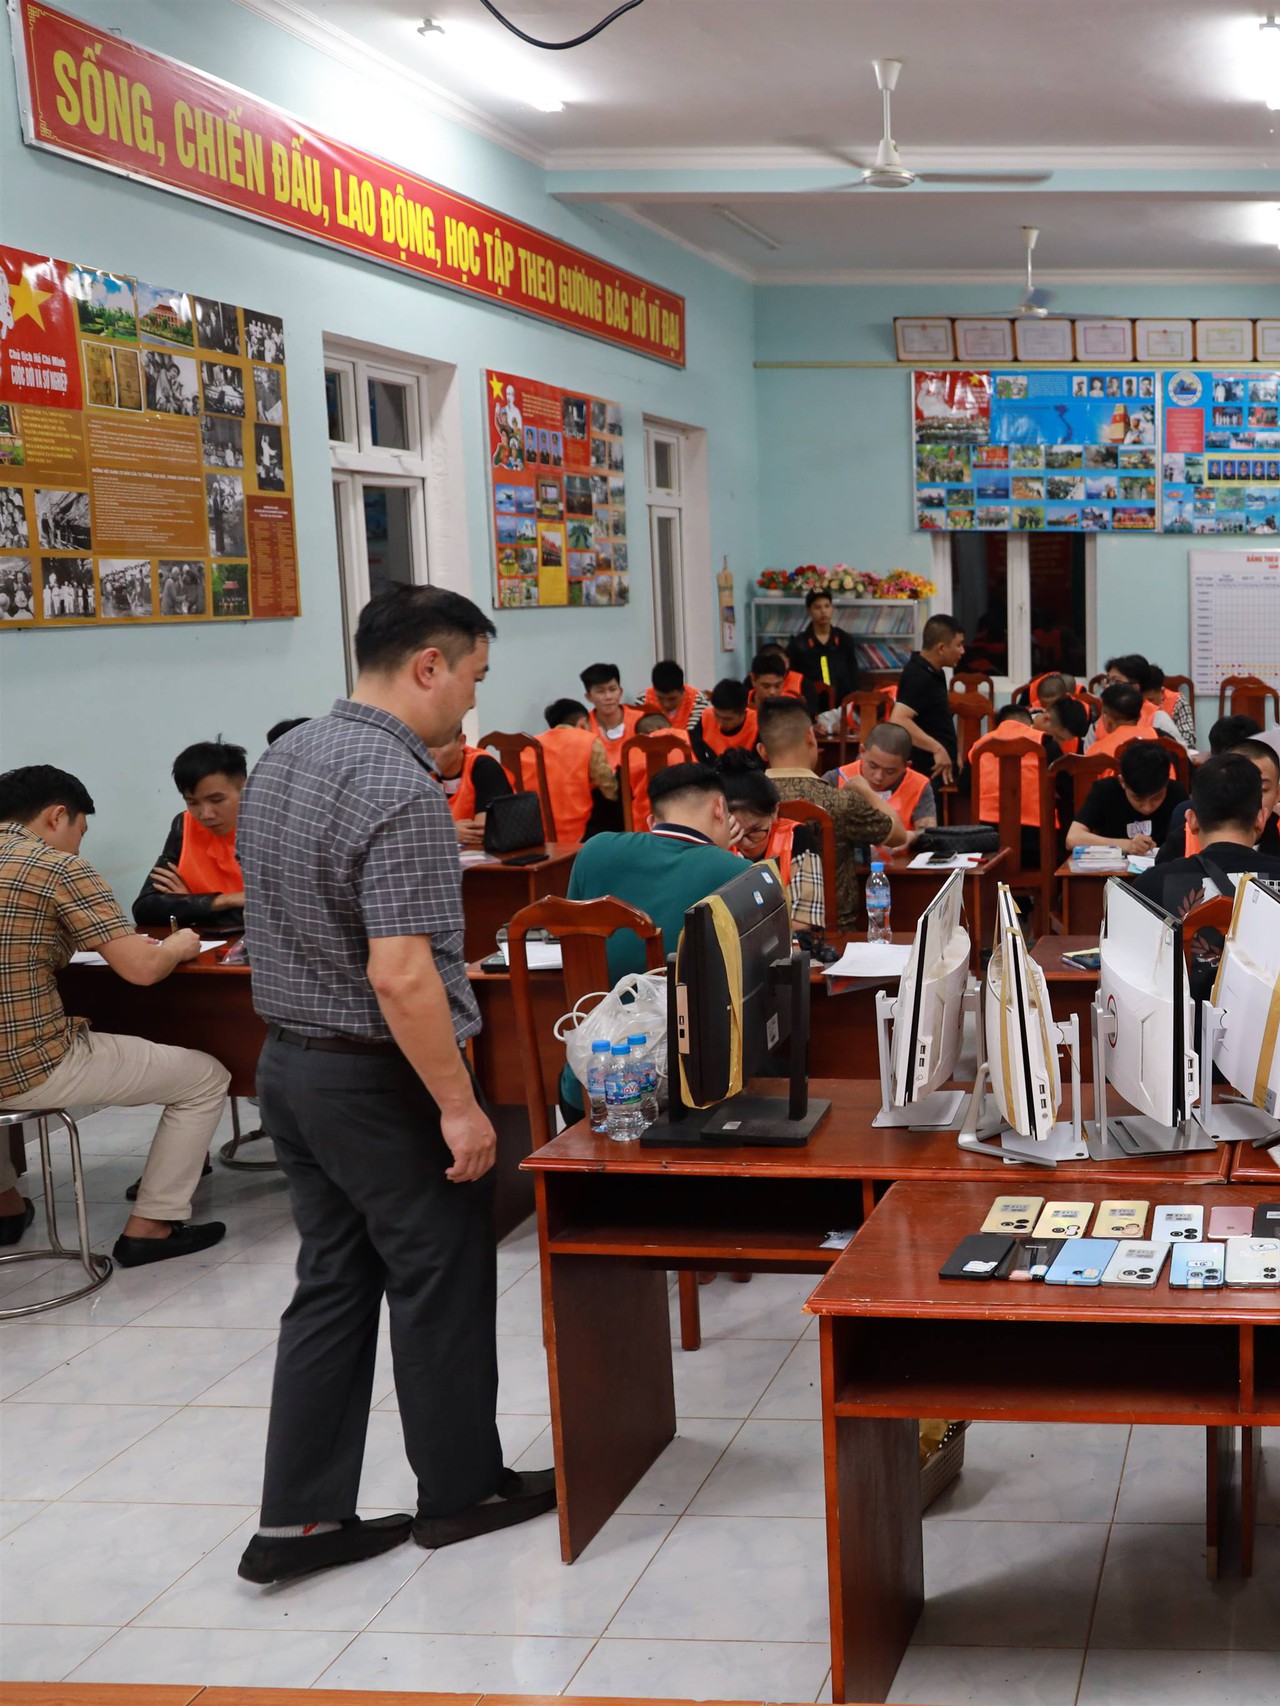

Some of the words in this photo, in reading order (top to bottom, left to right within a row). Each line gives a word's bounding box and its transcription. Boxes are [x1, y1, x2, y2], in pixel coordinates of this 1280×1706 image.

[53, 42, 166, 168] SỐNG,
[173, 104, 266, 196] CHIẾN
[271, 133, 330, 228] ĐẤU,
[333, 166, 376, 238] LAO
[380, 183, 442, 269] ĐỘNG,
[444, 215, 481, 283] HỌC
[483, 227, 515, 296] TẬP
[518, 247, 556, 305] THEO
[558, 264, 603, 323] GƯƠNG
[605, 279, 630, 333] BÁC
[661, 308, 680, 358] ĐẠI
